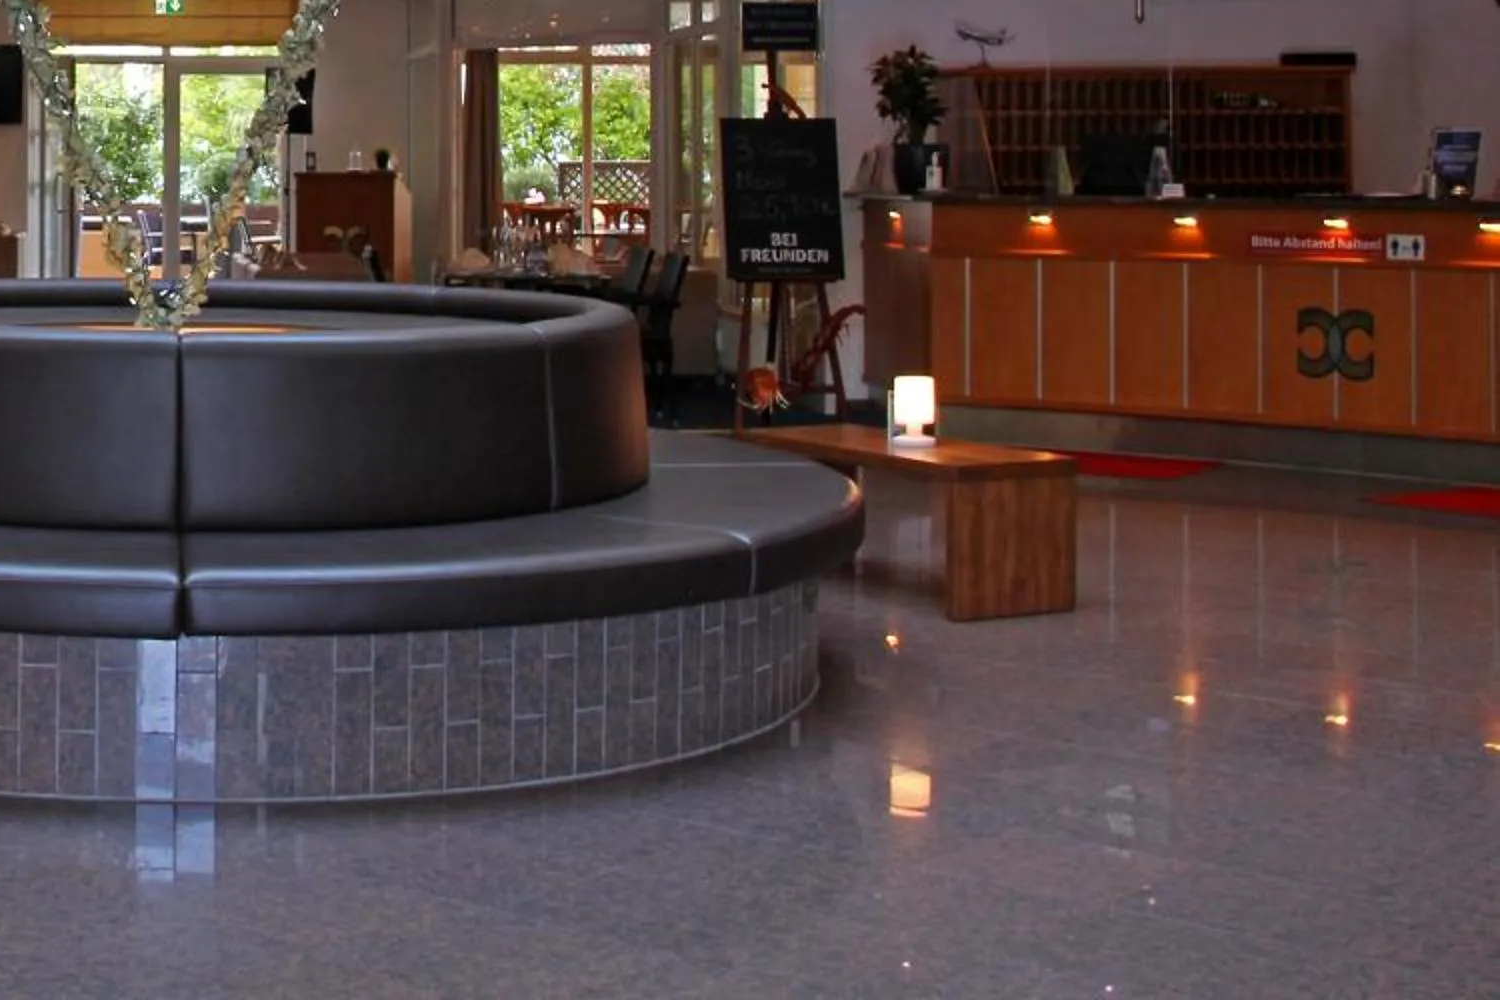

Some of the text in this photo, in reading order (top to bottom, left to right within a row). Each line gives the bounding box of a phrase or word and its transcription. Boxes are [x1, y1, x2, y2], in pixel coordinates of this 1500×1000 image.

[769, 232, 798, 247] BEI
[1250, 234, 1281, 249] Bitte
[1282, 236, 1335, 250] Abstand
[740, 247, 830, 264] FREUNDEN
